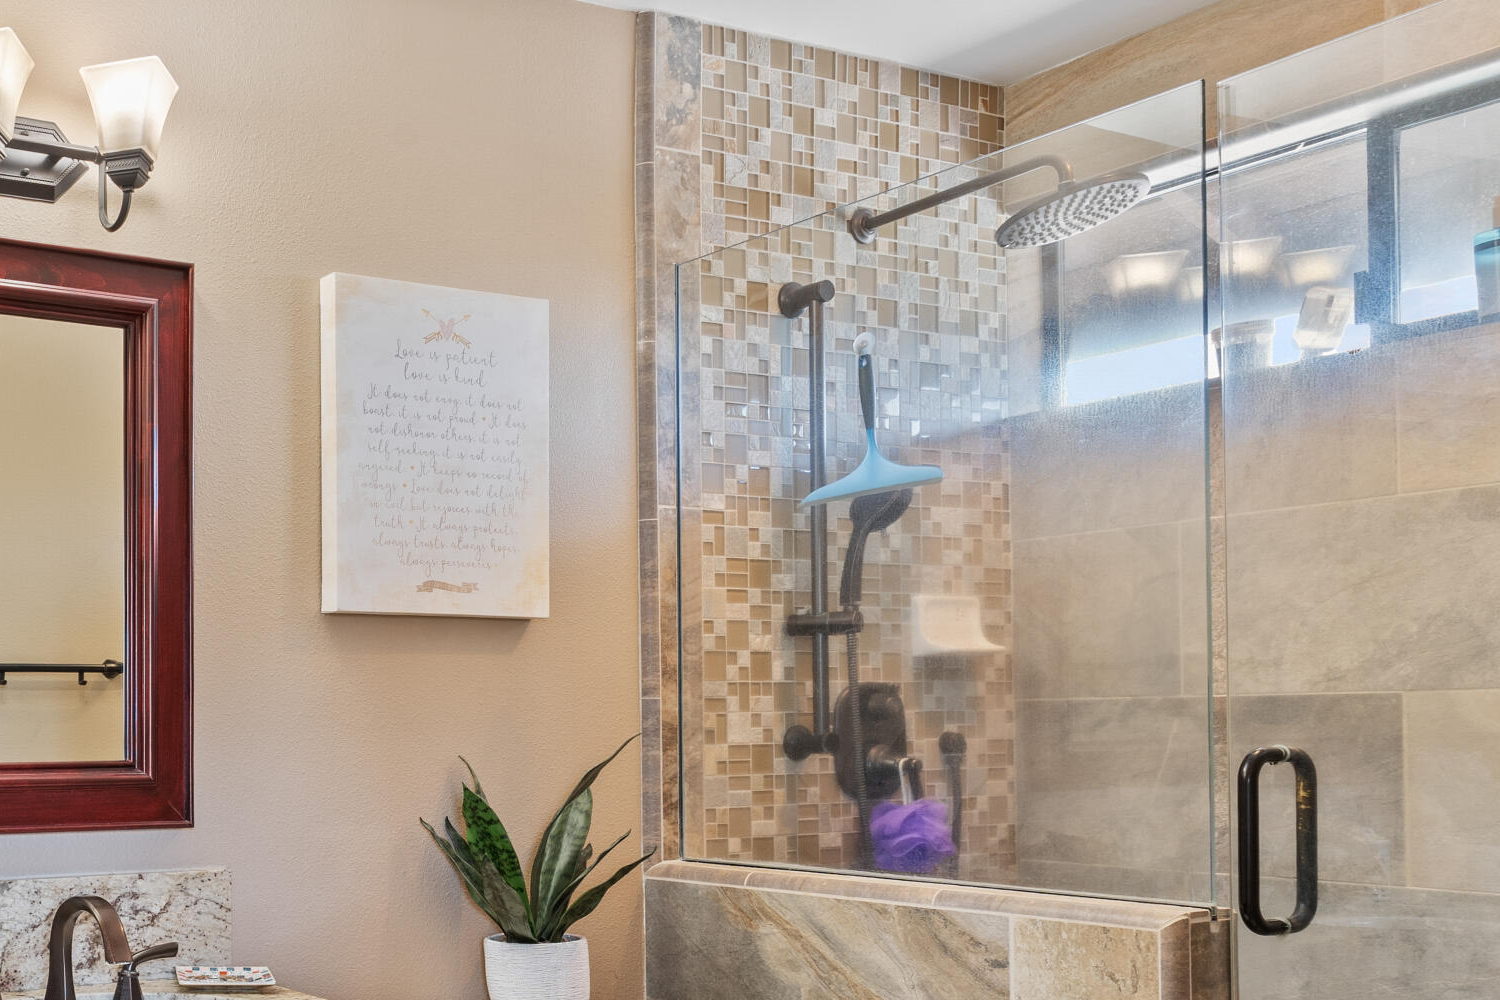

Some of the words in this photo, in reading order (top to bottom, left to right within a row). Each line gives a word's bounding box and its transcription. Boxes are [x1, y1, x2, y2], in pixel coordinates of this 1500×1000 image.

[394, 338, 424, 360] Love
[429, 351, 442, 361] is
[446, 347, 499, 370] patient
[438, 372, 453, 384] is
[454, 366, 489, 388] kind
[367, 382, 382, 400] It
[384, 384, 408, 400] does
[413, 390, 431, 403] not
[465, 393, 476, 407] it
[479, 394, 502, 409] does
[506, 400, 525, 412] not
[398, 405, 408, 419] it
[427, 407, 446, 423] not
[449, 411, 477, 430] proud
[489, 412, 502, 430] It
[506, 414, 528, 431] does
[368, 421, 387, 435] not
[391, 422, 437, 439] dishonor
[478, 430, 490, 445] it
[493, 432, 502, 446] is
[506, 433, 523, 448] not
[418, 458, 429, 478] It
[432, 462, 462, 484] keeps
[482, 467, 513, 482] record
[443, 445, 454, 459] it
[456, 449, 466, 461] is
[469, 448, 486, 463] not
[491, 450, 524, 475] easily
[411, 478, 434, 495] Love
[437, 479, 462, 497] does
[464, 484, 483, 498] not
[429, 501, 471, 523] rejoices
[474, 502, 499, 520] with
[373, 512, 405, 530] truth
[415, 513, 428, 532] It
[431, 516, 470, 541] always
[371, 532, 412, 559] always
[451, 535, 488, 562] always
[399, 552, 439, 578] always
[440, 559, 493, 573] perseveres
